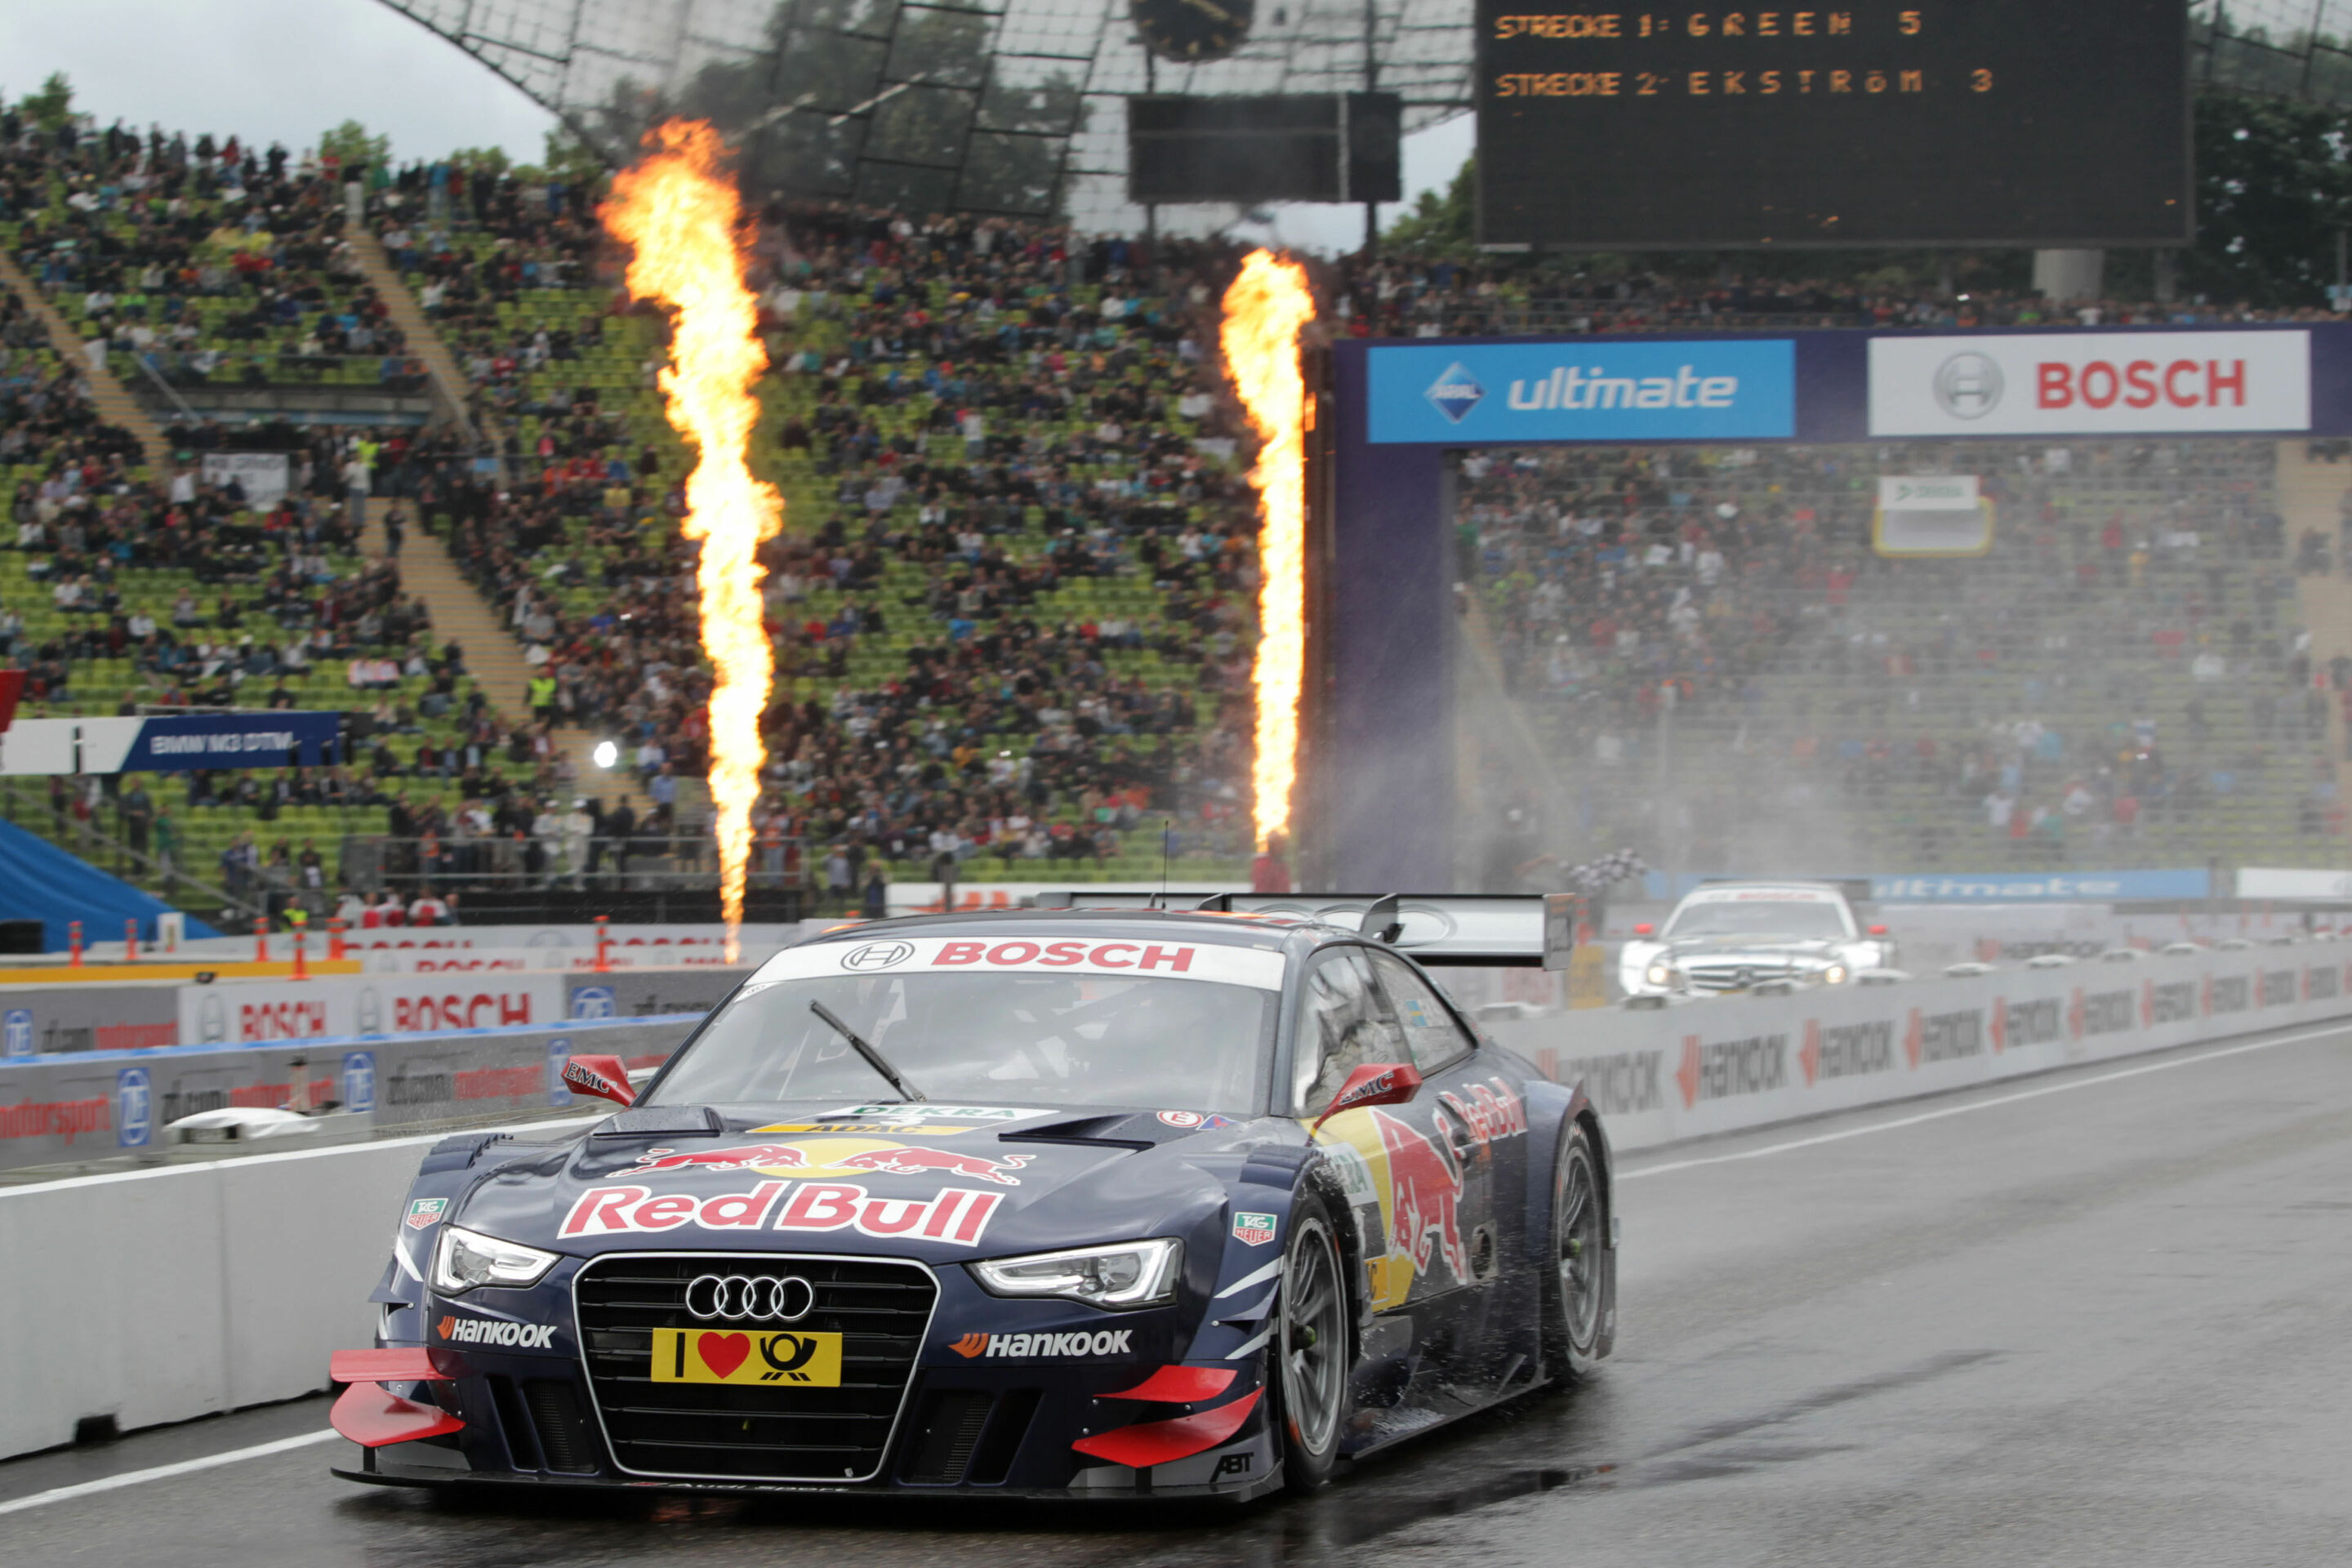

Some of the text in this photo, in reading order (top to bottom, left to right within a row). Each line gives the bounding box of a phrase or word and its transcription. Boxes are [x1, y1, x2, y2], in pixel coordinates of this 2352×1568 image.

[1494, 14, 1622, 38] STRECKE
[1899, 10, 1922, 35] 5
[1494, 72, 1623, 96] STRECKE
[1970, 68, 1993, 92] 3
[1507, 364, 1739, 411] ultimate
[2035, 358, 2247, 411] BOSCH
[151, 735, 205, 755] BMW
[931, 942, 1196, 972] BOSCH
[240, 1000, 326, 1042] BOSCH
[394, 992, 532, 1032] BOSCH
[566, 1061, 611, 1094] EMC
[849, 1106, 1018, 1119] DEKRA
[804, 1125, 924, 1134] ADAC
[410, 1214, 439, 1227] HEUER
[417, 1200, 439, 1213] TAG
[560, 1181, 1004, 1247] Red Bull
[1236, 1228, 1272, 1243] HEUER
[1242, 1215, 1270, 1228] TAG
[1209, 1451, 1255, 1483] ABT
